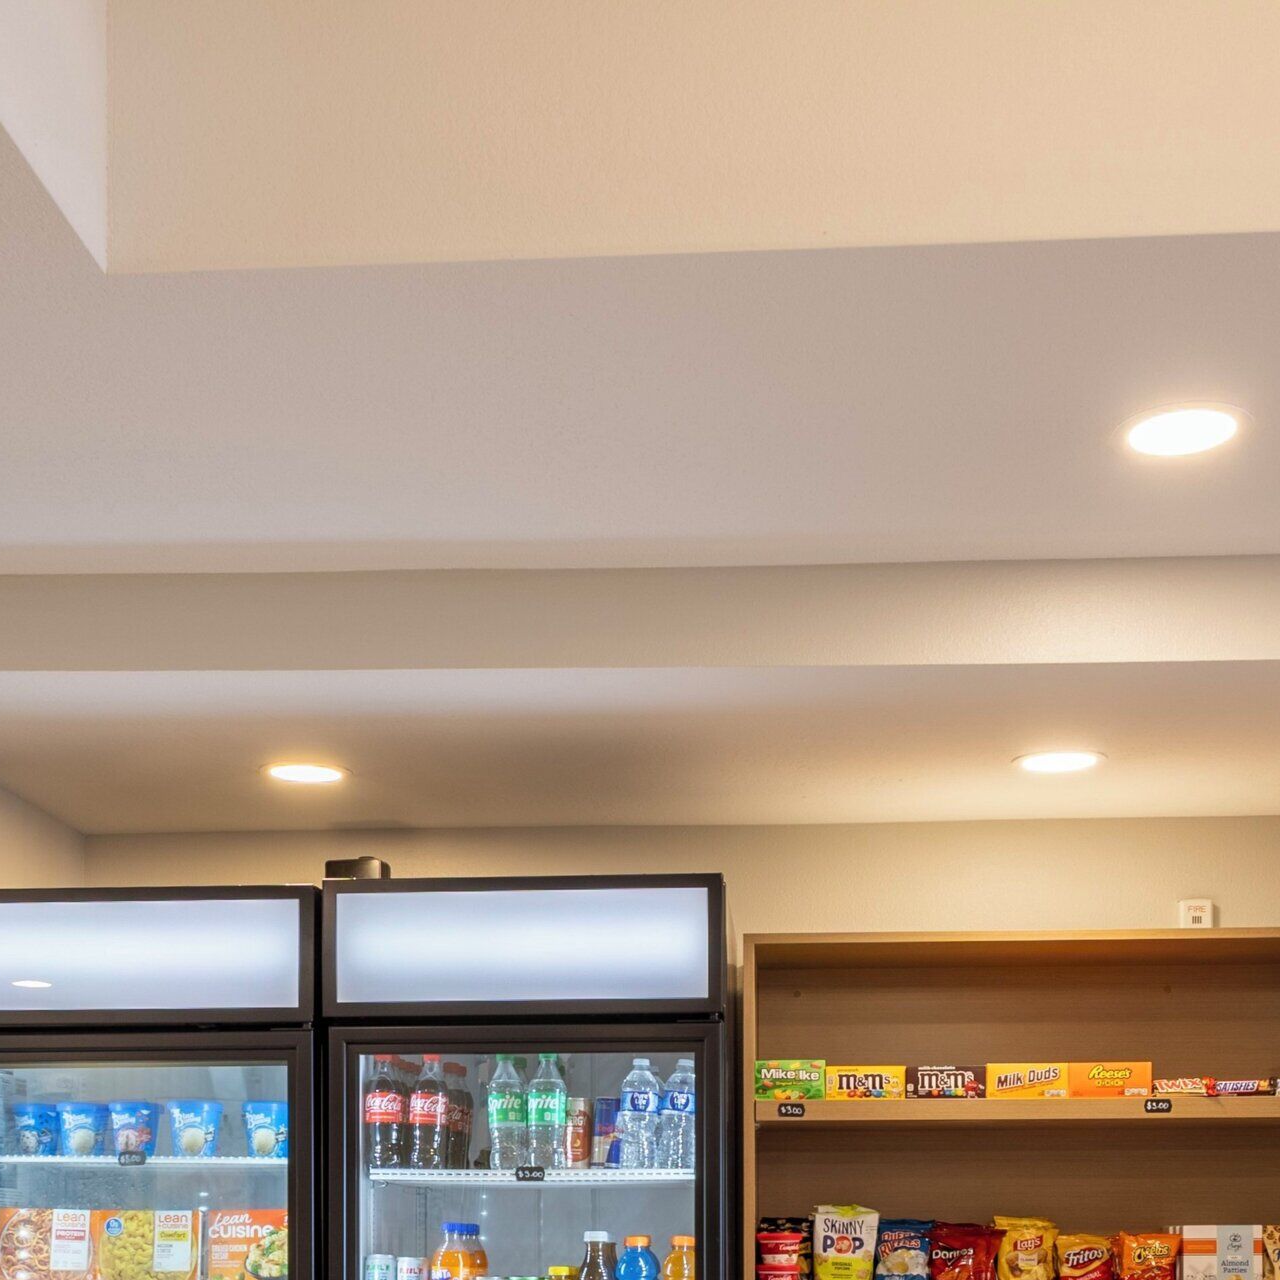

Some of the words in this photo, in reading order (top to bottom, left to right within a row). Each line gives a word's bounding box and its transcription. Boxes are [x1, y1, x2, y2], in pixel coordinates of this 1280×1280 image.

[761, 1068, 796, 1079] Mike
[799, 1070, 820, 1080] Ike
[996, 1073, 1024, 1089] Milk
[1028, 1067, 1059, 1083] Duds
[1156, 1079, 1201, 1092] TWIX
[1216, 1081, 1257, 1092] SATISFIES
[488, 1094, 521, 1112] Sprite
[780, 1105, 803, 1114] $3.00
[517, 1170, 543, 1179] $3.00
[57, 1213, 86, 1222] Lean
[159, 1214, 188, 1223] Lean
[213, 1212, 253, 1227] Lean
[822, 1235, 864, 1254] POP
[932, 1248, 974, 1259] Doritos
[1065, 1249, 1104, 1267] Fritos
